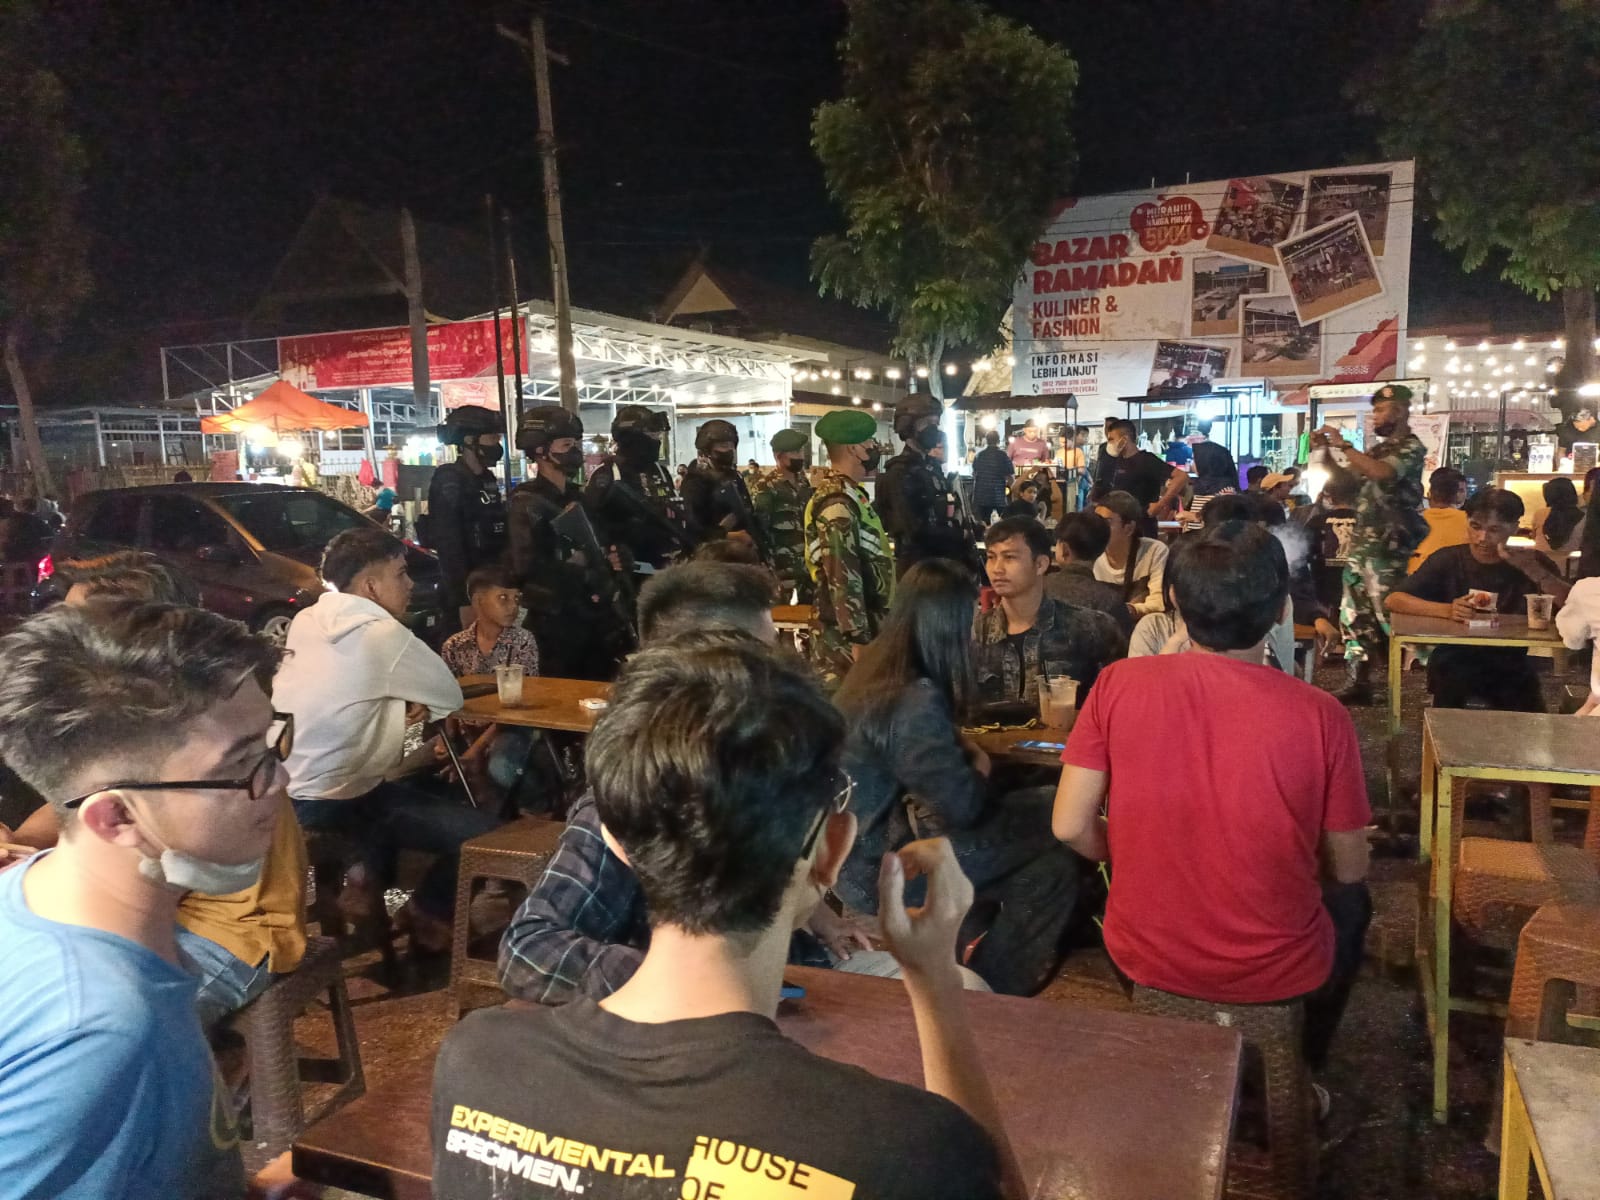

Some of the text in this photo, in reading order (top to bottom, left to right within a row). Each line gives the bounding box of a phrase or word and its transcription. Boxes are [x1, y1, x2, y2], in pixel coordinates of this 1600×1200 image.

[1031, 234, 1129, 267] BAZAR
[1033, 256, 1184, 294] RAMADAN
[1033, 295, 1118, 319] KULINER &
[1032, 317, 1100, 338] FASHION
[1032, 352, 1098, 366] INFORMASI
[1032, 365, 1098, 378] LEBIH LANJUT
[450, 1104, 676, 1178] EXPERIMENTAL
[445, 1128, 585, 1194] SPECIMEN.
[693, 1136, 811, 1190] HOUSE
